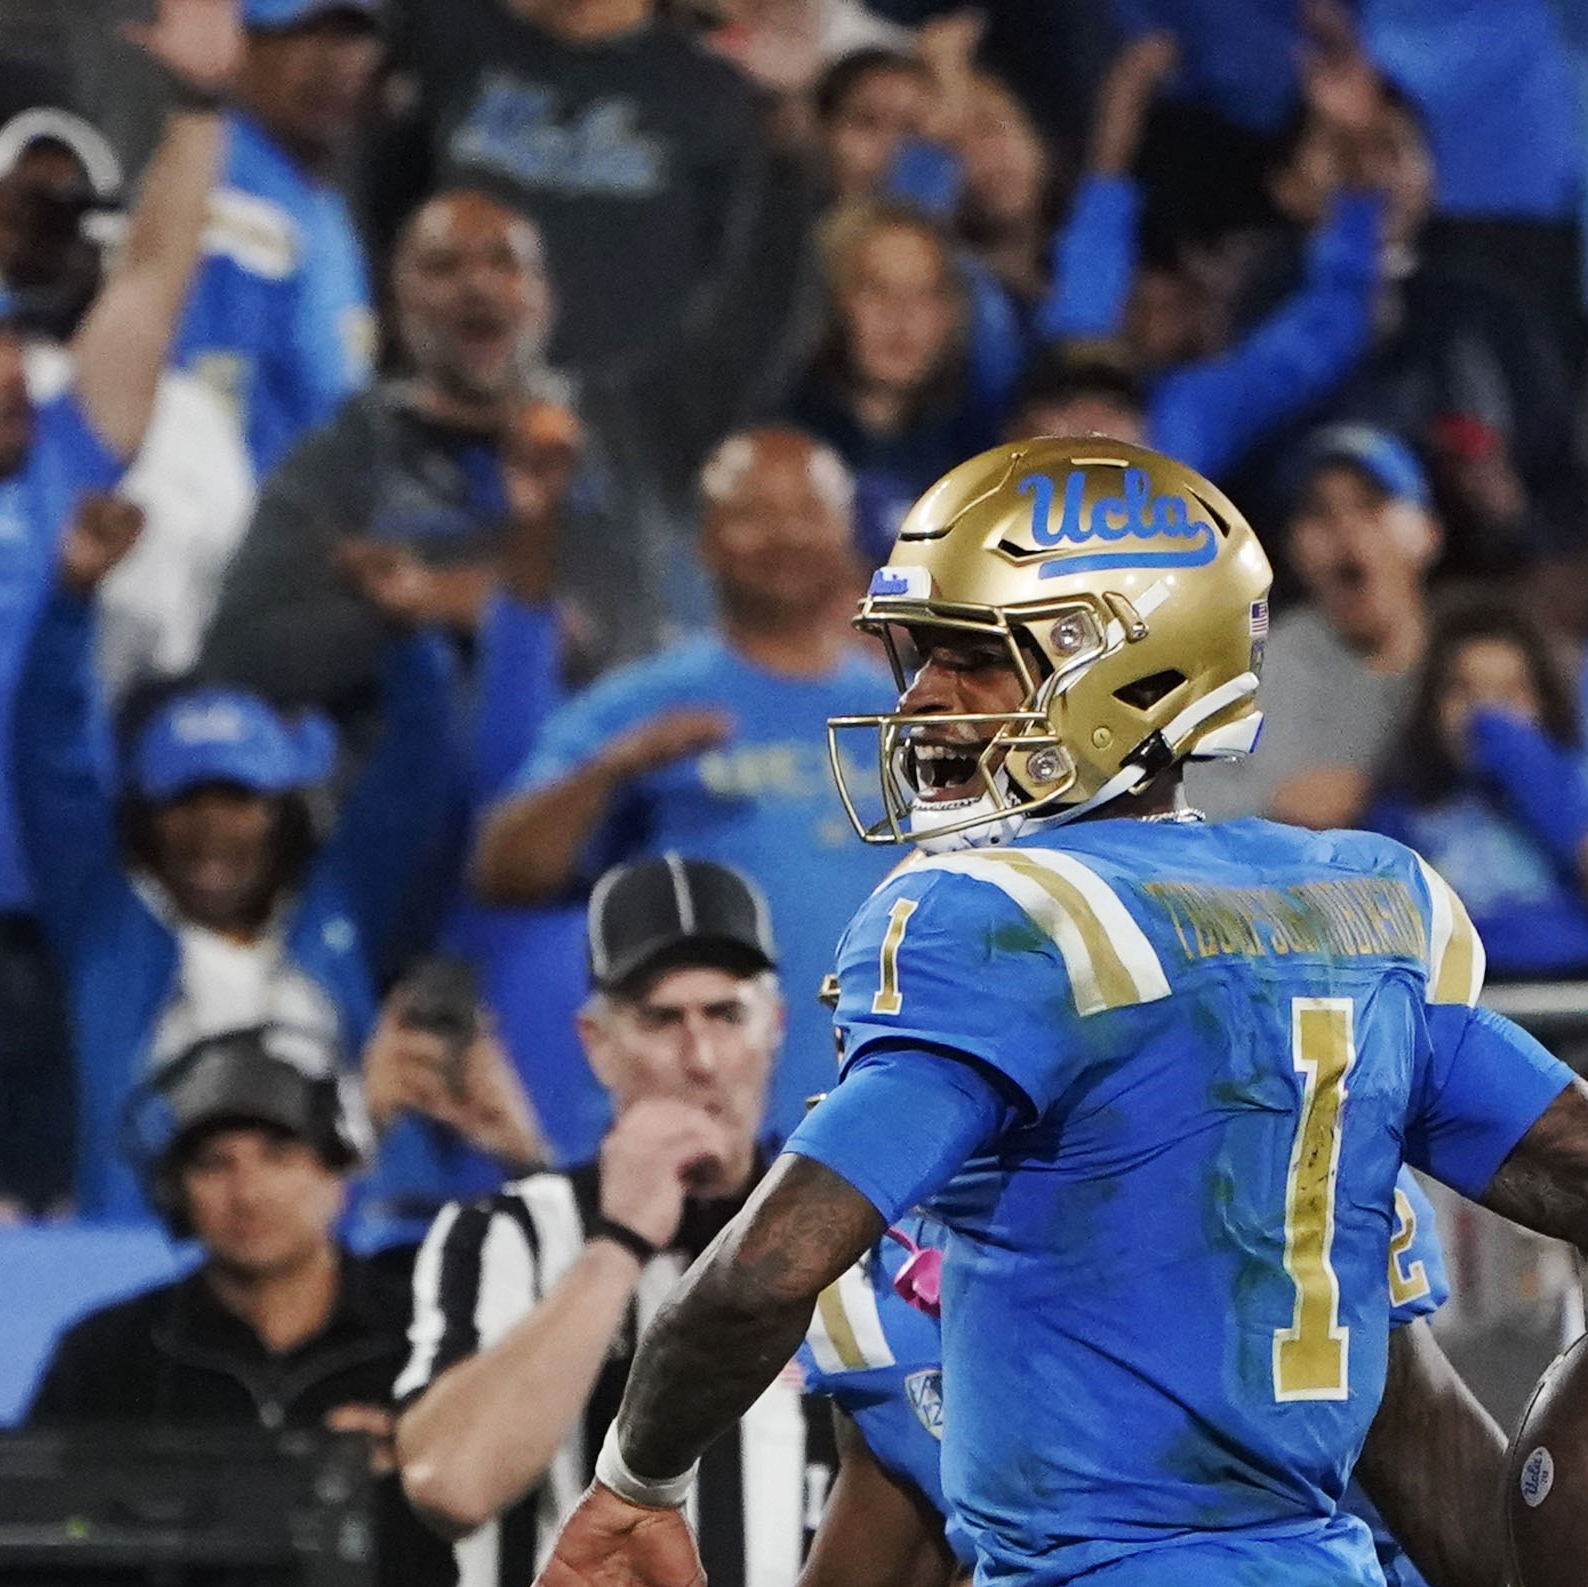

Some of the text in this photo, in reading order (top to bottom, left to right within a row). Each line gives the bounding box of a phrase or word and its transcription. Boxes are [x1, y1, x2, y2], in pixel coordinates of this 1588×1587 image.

[1017, 467, 1215, 550] Ucla
[872, 897, 919, 1015] 1
[1272, 997, 1355, 1402] 1
